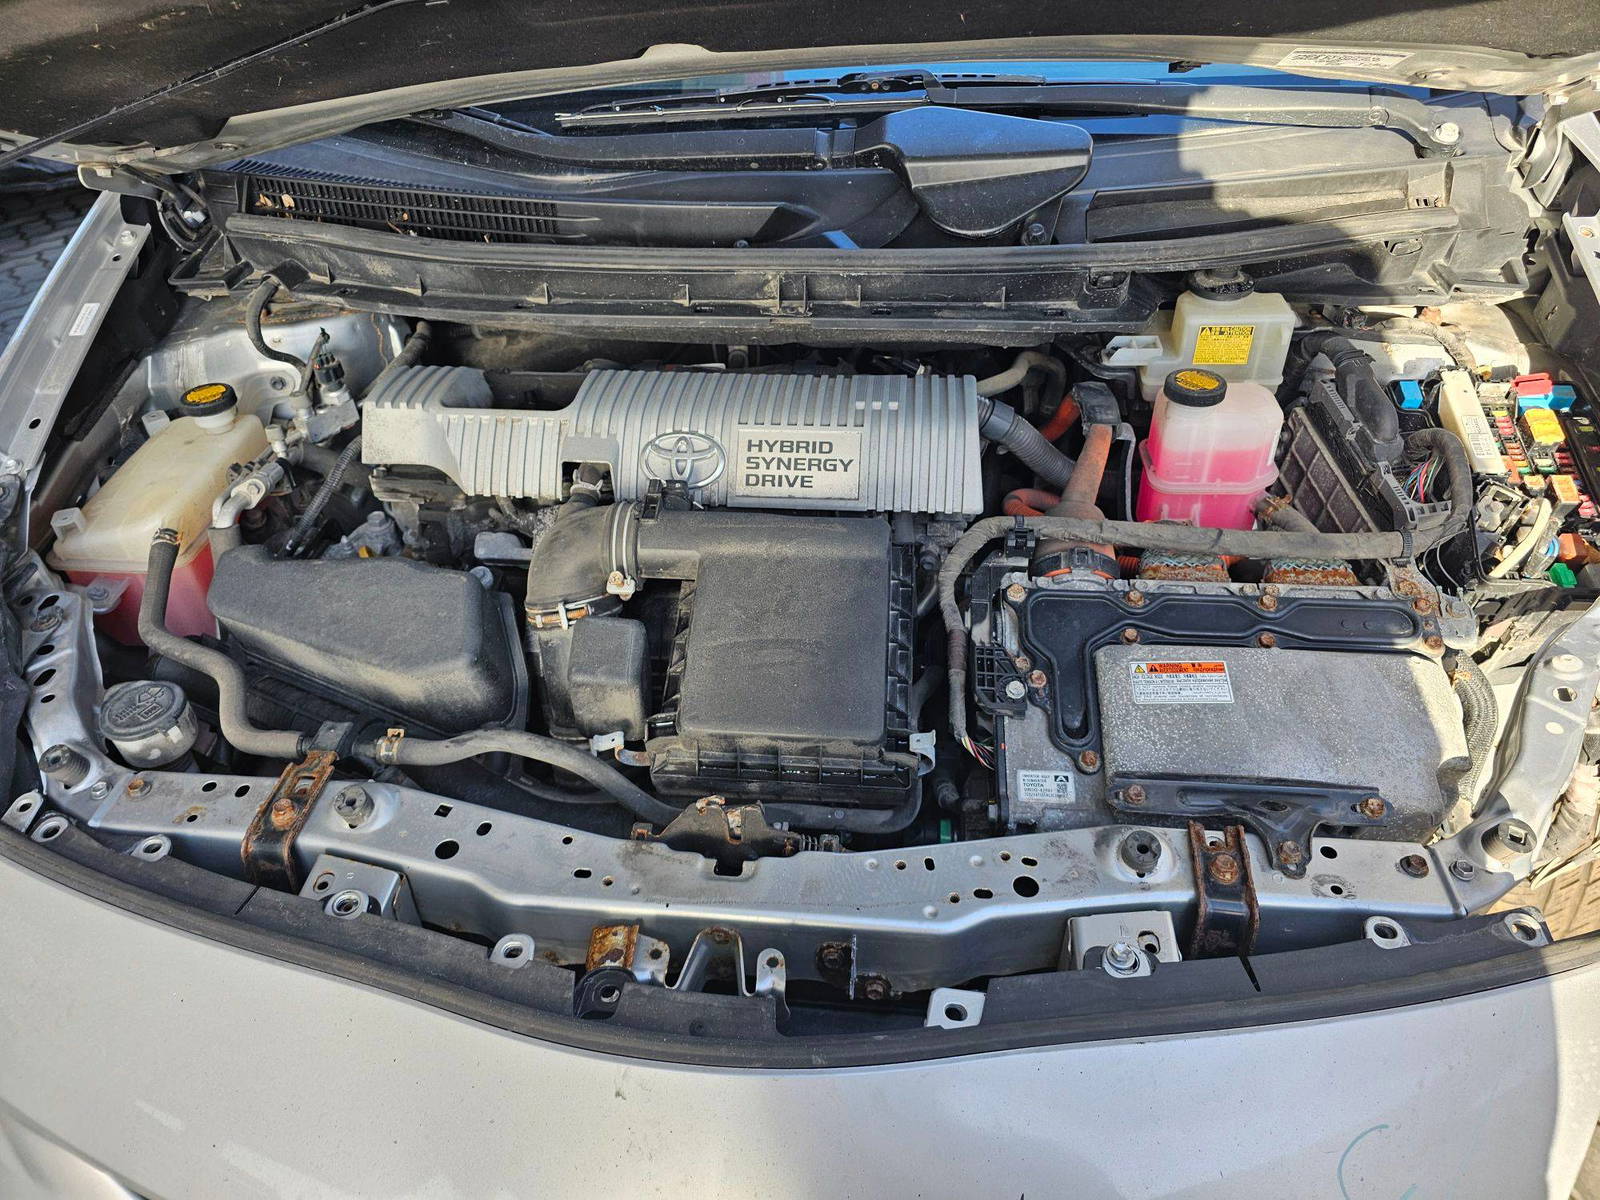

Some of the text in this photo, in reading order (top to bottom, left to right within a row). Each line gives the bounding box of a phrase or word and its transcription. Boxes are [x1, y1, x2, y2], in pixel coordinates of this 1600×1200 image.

[747, 439, 833, 454] HYBRID
[745, 456, 854, 472] SYNERGY
[745, 473, 814, 489] DRIVE
